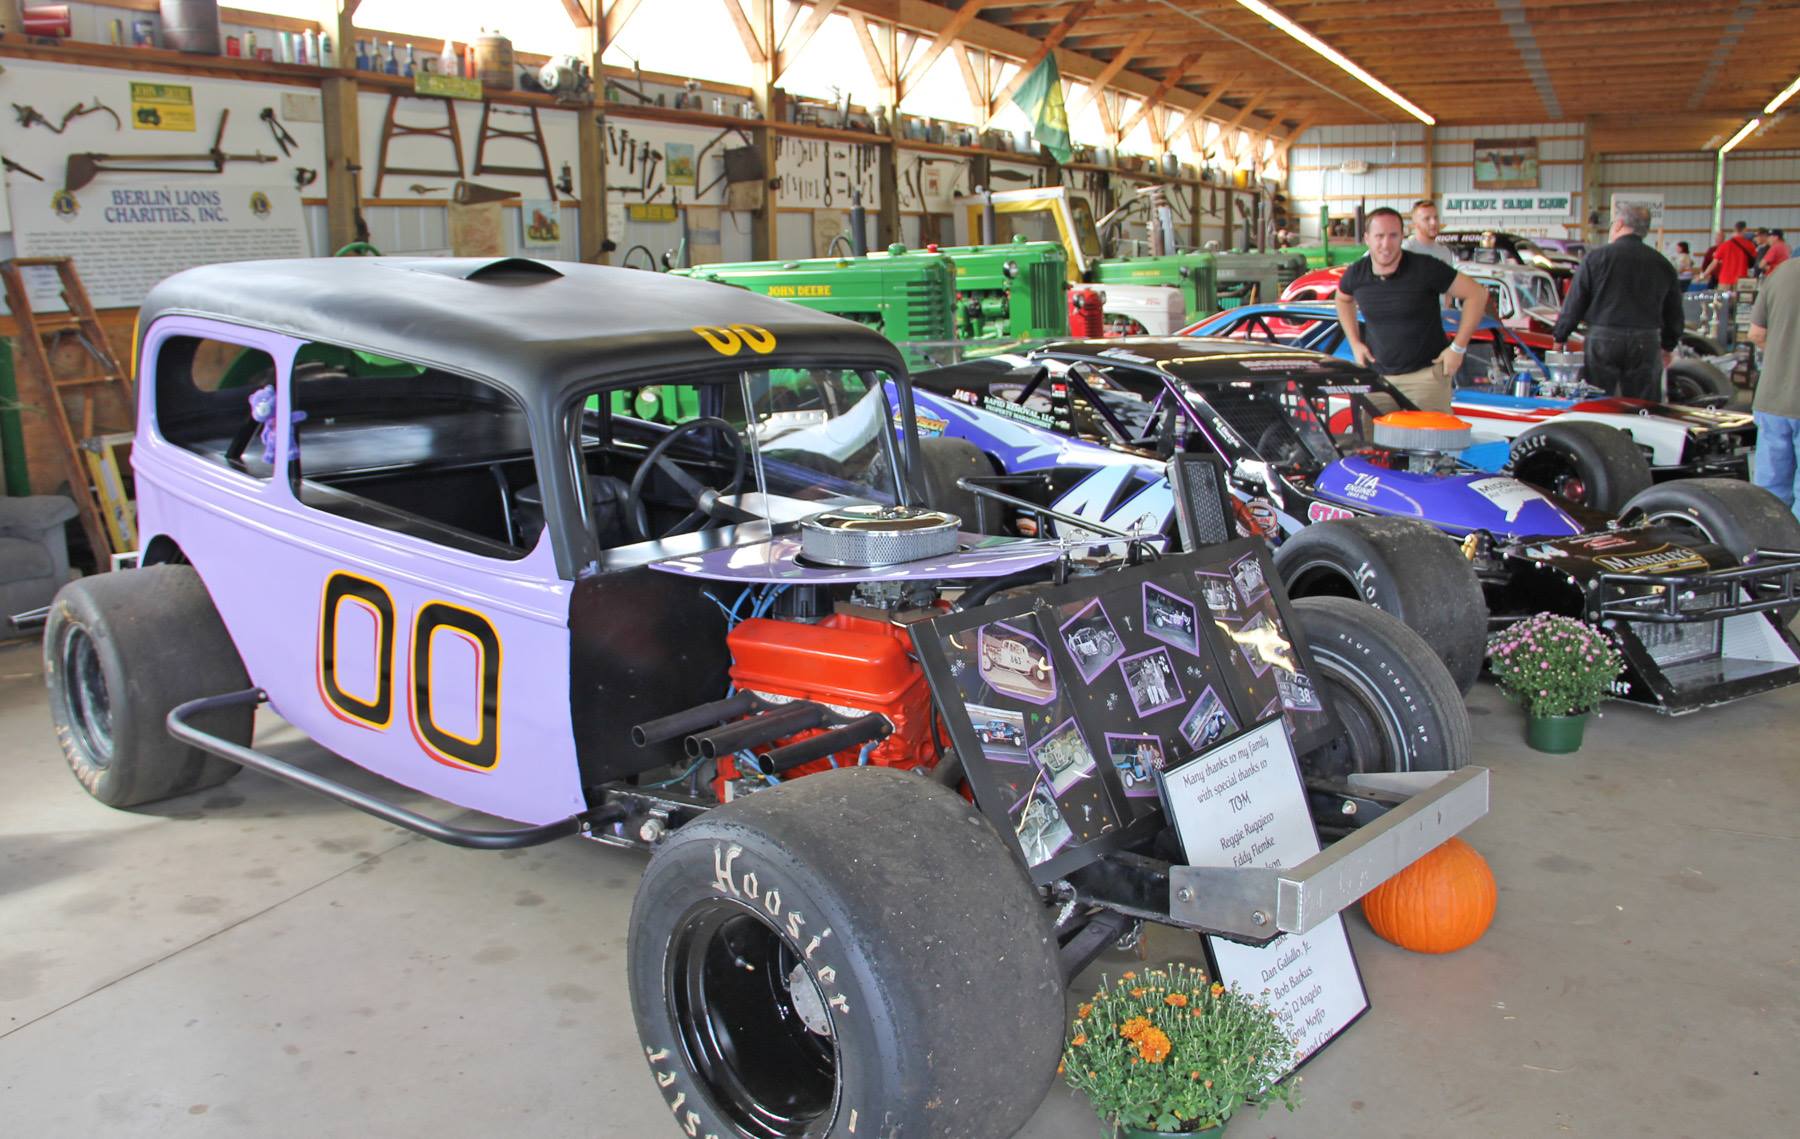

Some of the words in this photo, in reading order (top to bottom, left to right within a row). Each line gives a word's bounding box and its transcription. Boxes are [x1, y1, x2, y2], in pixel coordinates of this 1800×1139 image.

[112, 190, 172, 206] BERLIN
[175, 190, 221, 206] LIONS
[1446, 199, 1497, 212] ANTIQUE
[1503, 198, 1533, 210] FARM
[1538, 198, 1568, 210] EQUIP
[104, 207, 195, 224] CHARITIES,
[199, 207, 229, 222] INC.
[768, 285, 795, 297] JOHN
[797, 285, 832, 296] DEERE
[692, 324, 776, 356] 00
[984, 396, 1006, 409] RAPID
[1006, 401, 1040, 420] REMOVAL,
[1041, 413, 1056, 425] LLC
[1344, 483, 1378, 498] ENGINES
[1354, 472, 1380, 489] T/A
[317, 569, 503, 776] 00
[1339, 633, 1370, 655] BLUE
[1379, 661, 1417, 713] STREAK
[1417, 724, 1429, 743] HP
[1183, 770, 1206, 788] Many
[1205, 756, 1229, 777] thanks
[1229, 752, 1237, 764] to
[1237, 748, 1249, 760] my
[1248, 735, 1270, 757] family
[1197, 785, 1213, 804] with
[1213, 771, 1238, 797] special
[1237, 762, 1260, 782] thanks
[1259, 759, 1268, 770] to
[1228, 790, 1252, 814] TOM
[1219, 829, 1245, 851] Reggie
[1243, 812, 1275, 836] Ruggiero
[1232, 850, 1253, 869] Eddy
[1250, 836, 1276, 858] Flemke
[1261, 966, 1278, 984] Dan
[1273, 982, 1290, 1001] Bob
[1277, 1009, 1294, 1026] Ray
[1291, 985, 1322, 1013] D'Angelo
[1304, 1007, 1326, 1030] Moffo
